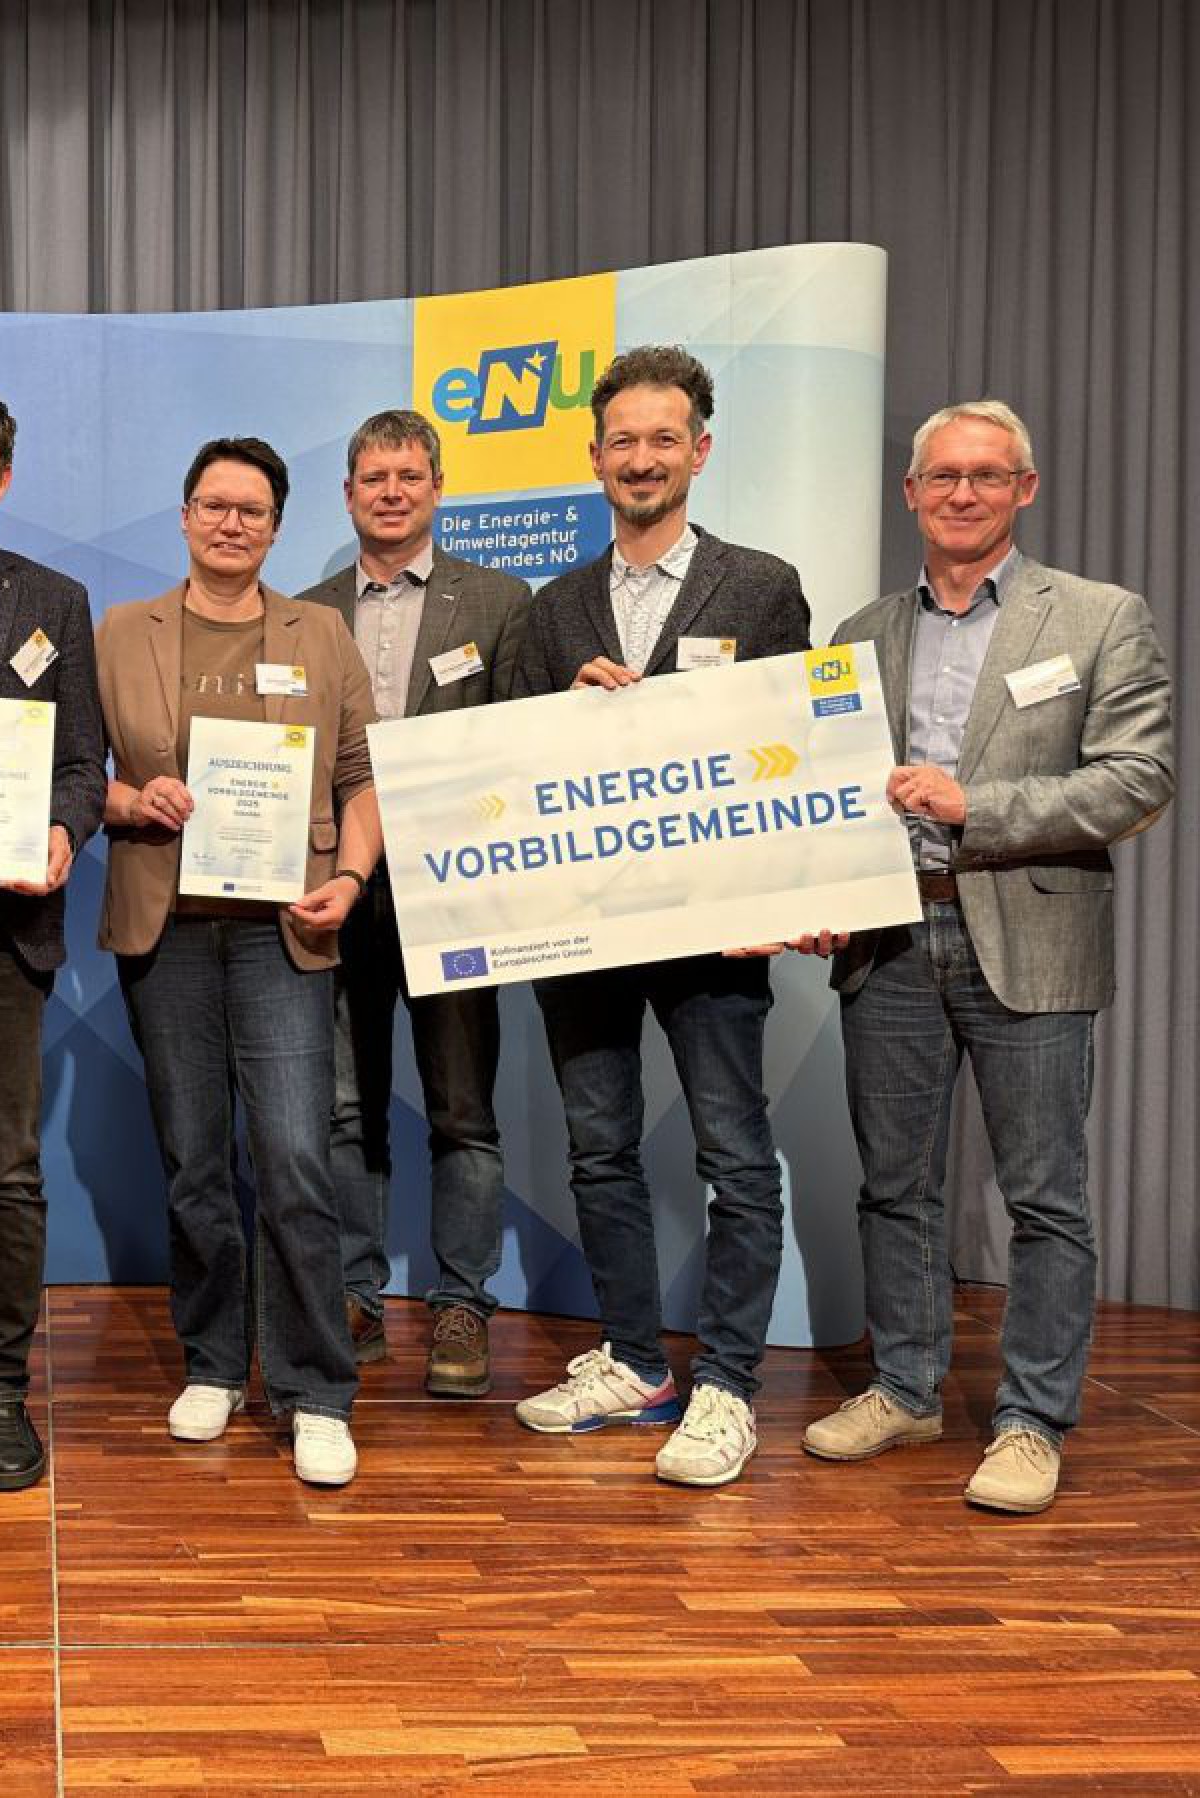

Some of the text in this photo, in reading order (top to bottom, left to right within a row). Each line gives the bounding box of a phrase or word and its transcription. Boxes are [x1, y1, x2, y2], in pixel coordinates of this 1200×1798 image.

[441, 505, 578, 533] Die Energie- &
[441, 528, 577, 552] Umweltagentur
[550, 543, 577, 563] NÖ
[207, 757, 292, 774] AUSZEICHNUNG
[229, 778, 268, 788] ENERGIE
[535, 753, 736, 816] ENERGIE
[207, 787, 289, 801] VORBILDGEMEINDE
[424, 785, 867, 883] VORBILDGEMEINDE
[490, 935, 589, 956] Kofinanziert von der
[562, 947, 593, 958] Union
